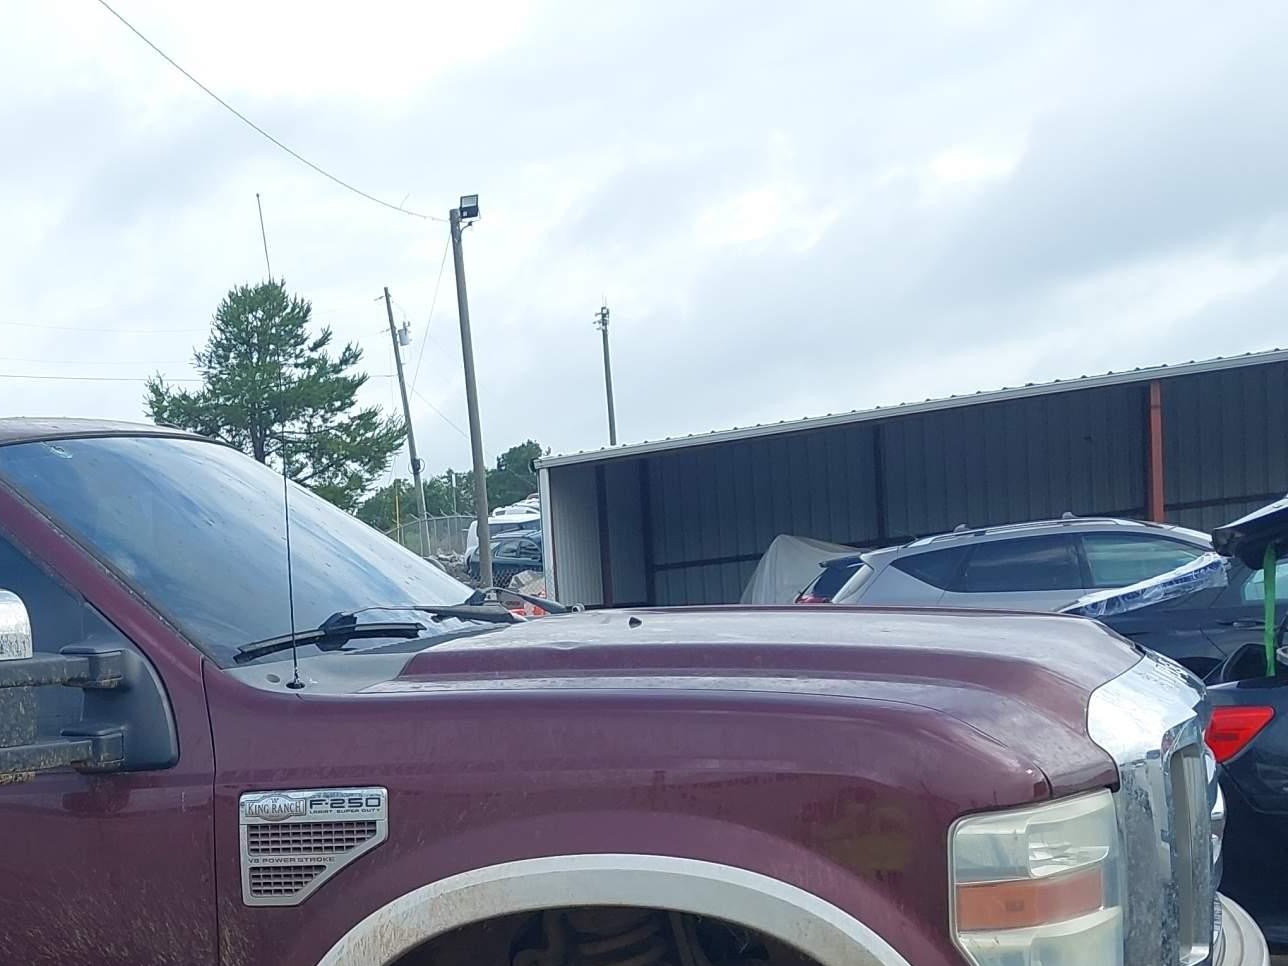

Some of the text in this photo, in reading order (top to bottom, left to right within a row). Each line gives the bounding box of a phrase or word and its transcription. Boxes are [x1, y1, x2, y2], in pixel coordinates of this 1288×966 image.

[248, 800, 301, 816] KING RANCH
[309, 797, 381, 810] F-250
